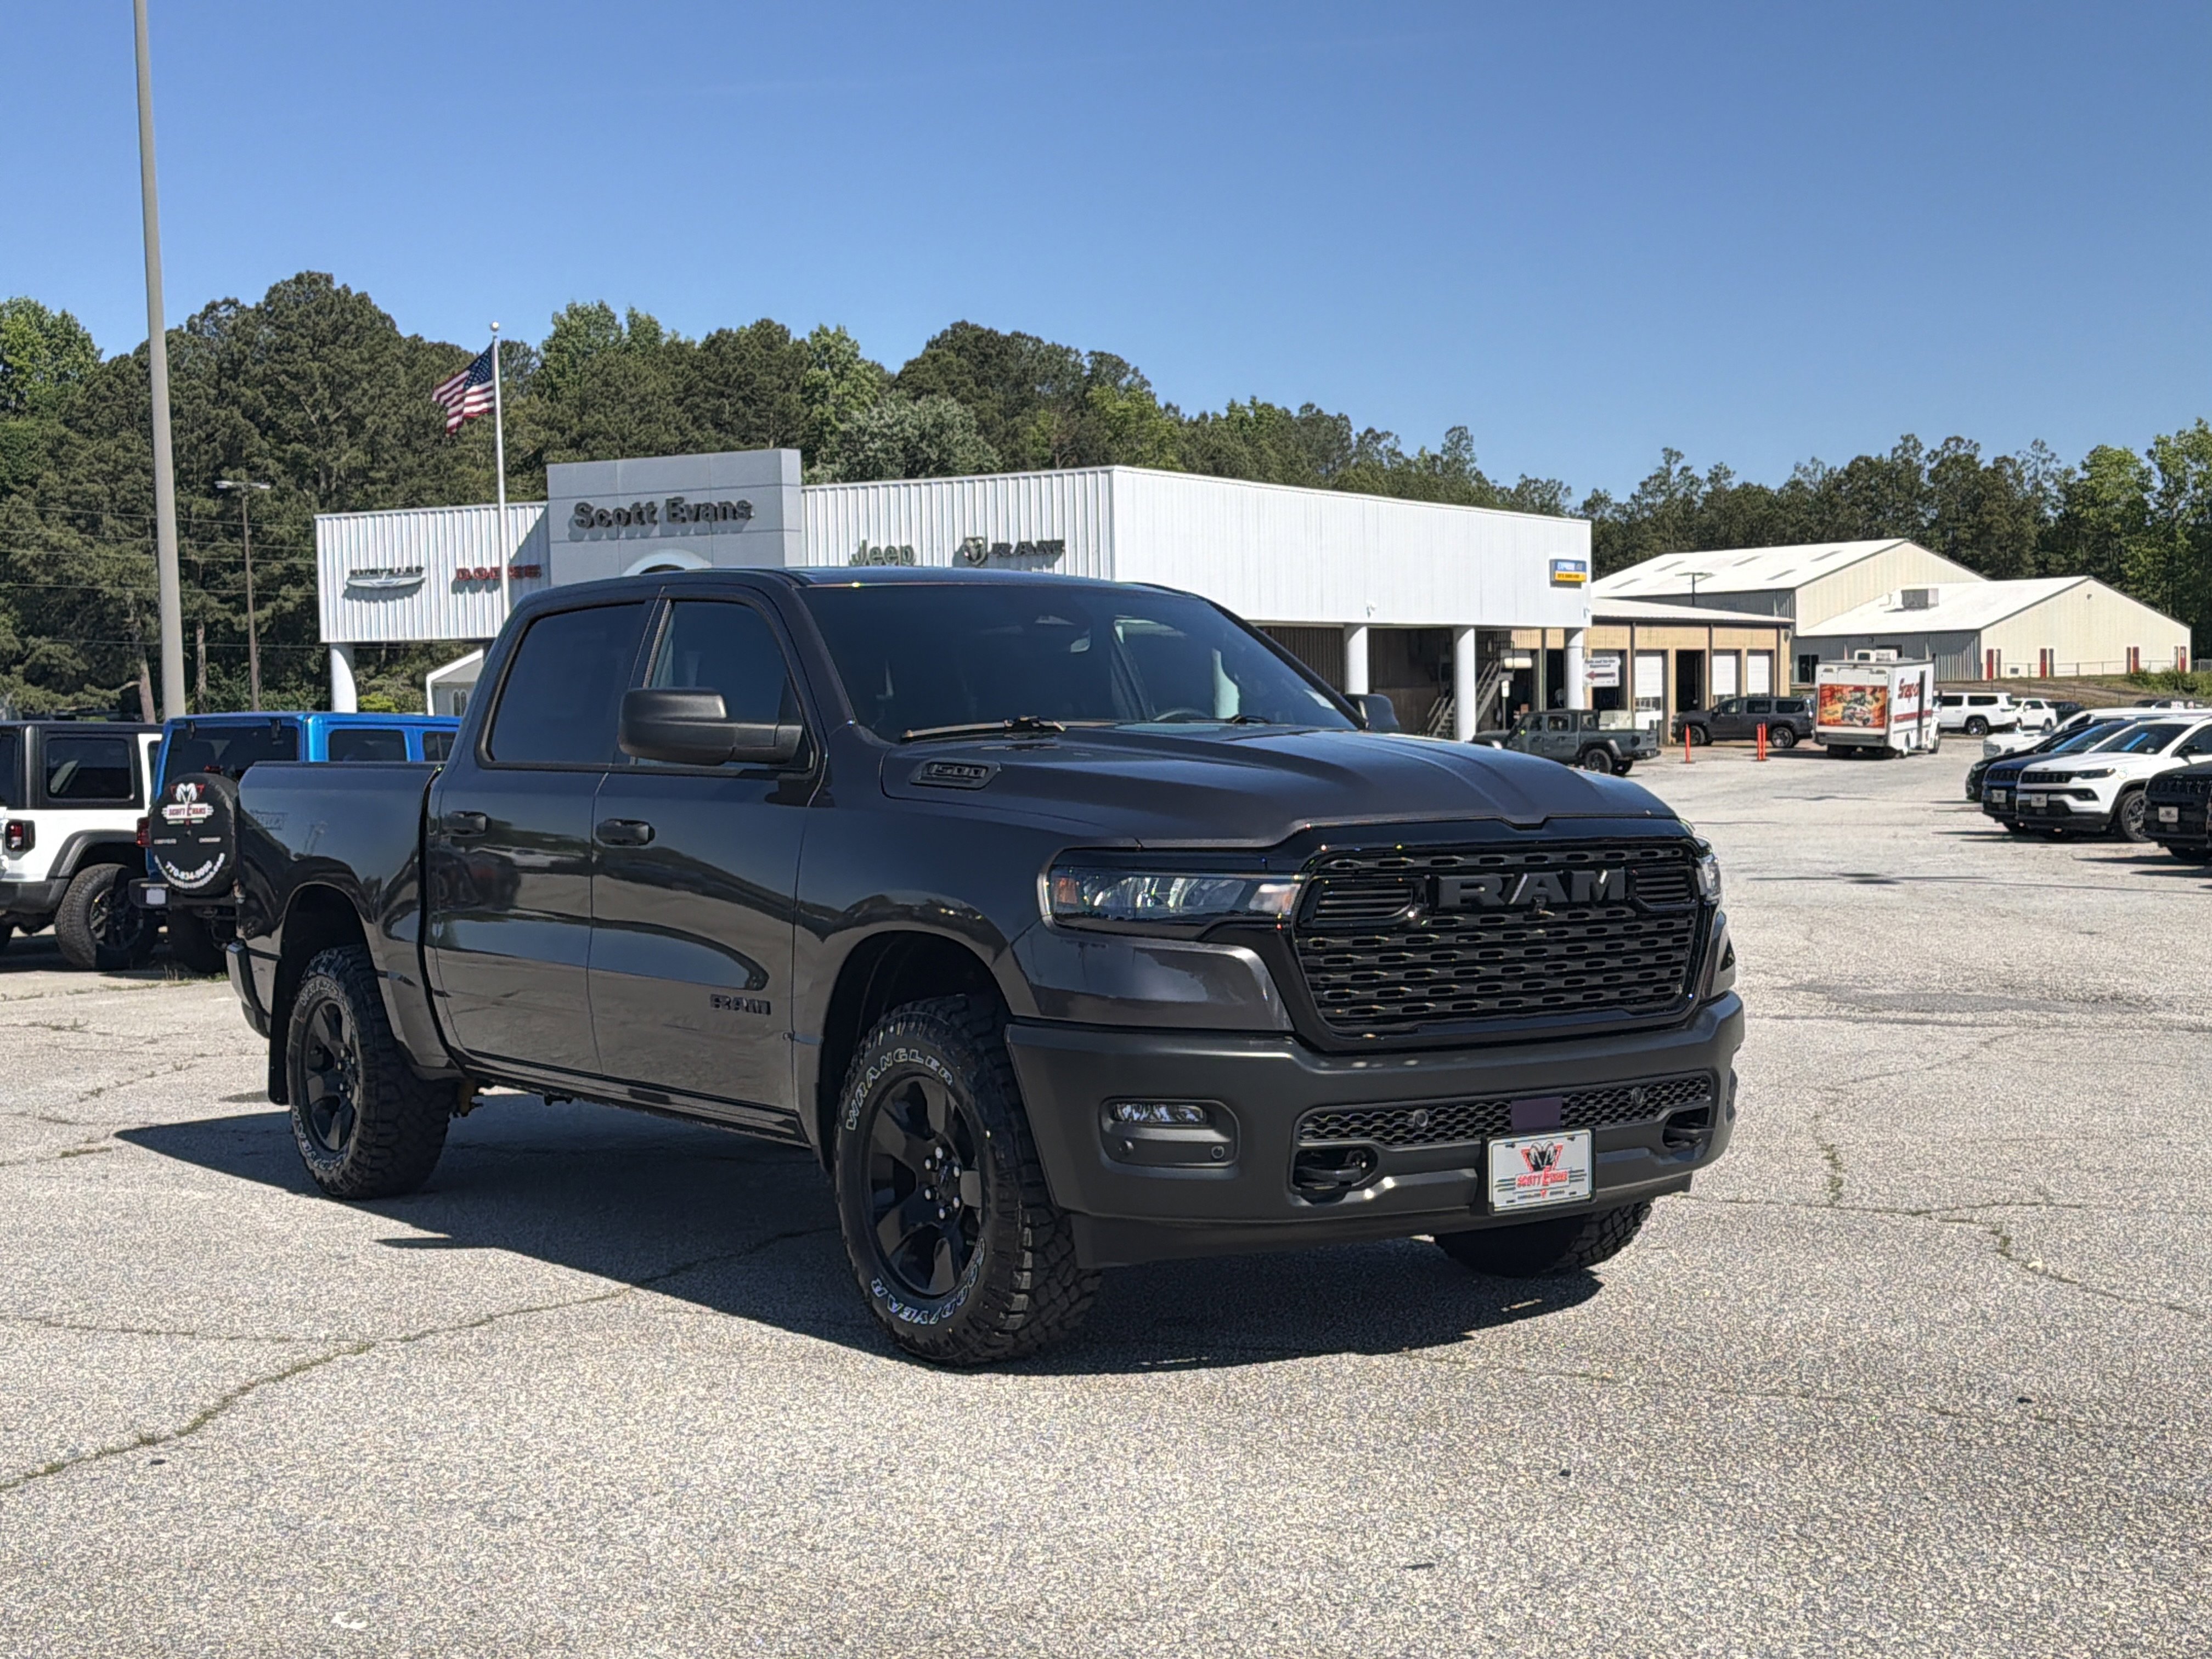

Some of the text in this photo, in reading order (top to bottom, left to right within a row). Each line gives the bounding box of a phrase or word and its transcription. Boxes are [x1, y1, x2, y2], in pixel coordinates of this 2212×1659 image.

[574, 496, 753, 529] Scott Evans
[851, 540, 915, 566] Jeep
[991, 540, 1065, 556] RAM
[1438, 869, 1626, 909] RAM
[709, 994, 771, 1015] RAM
[845, 1047, 954, 1131] WRANGLER
[1517, 1175, 1542, 1188] SCOTT
